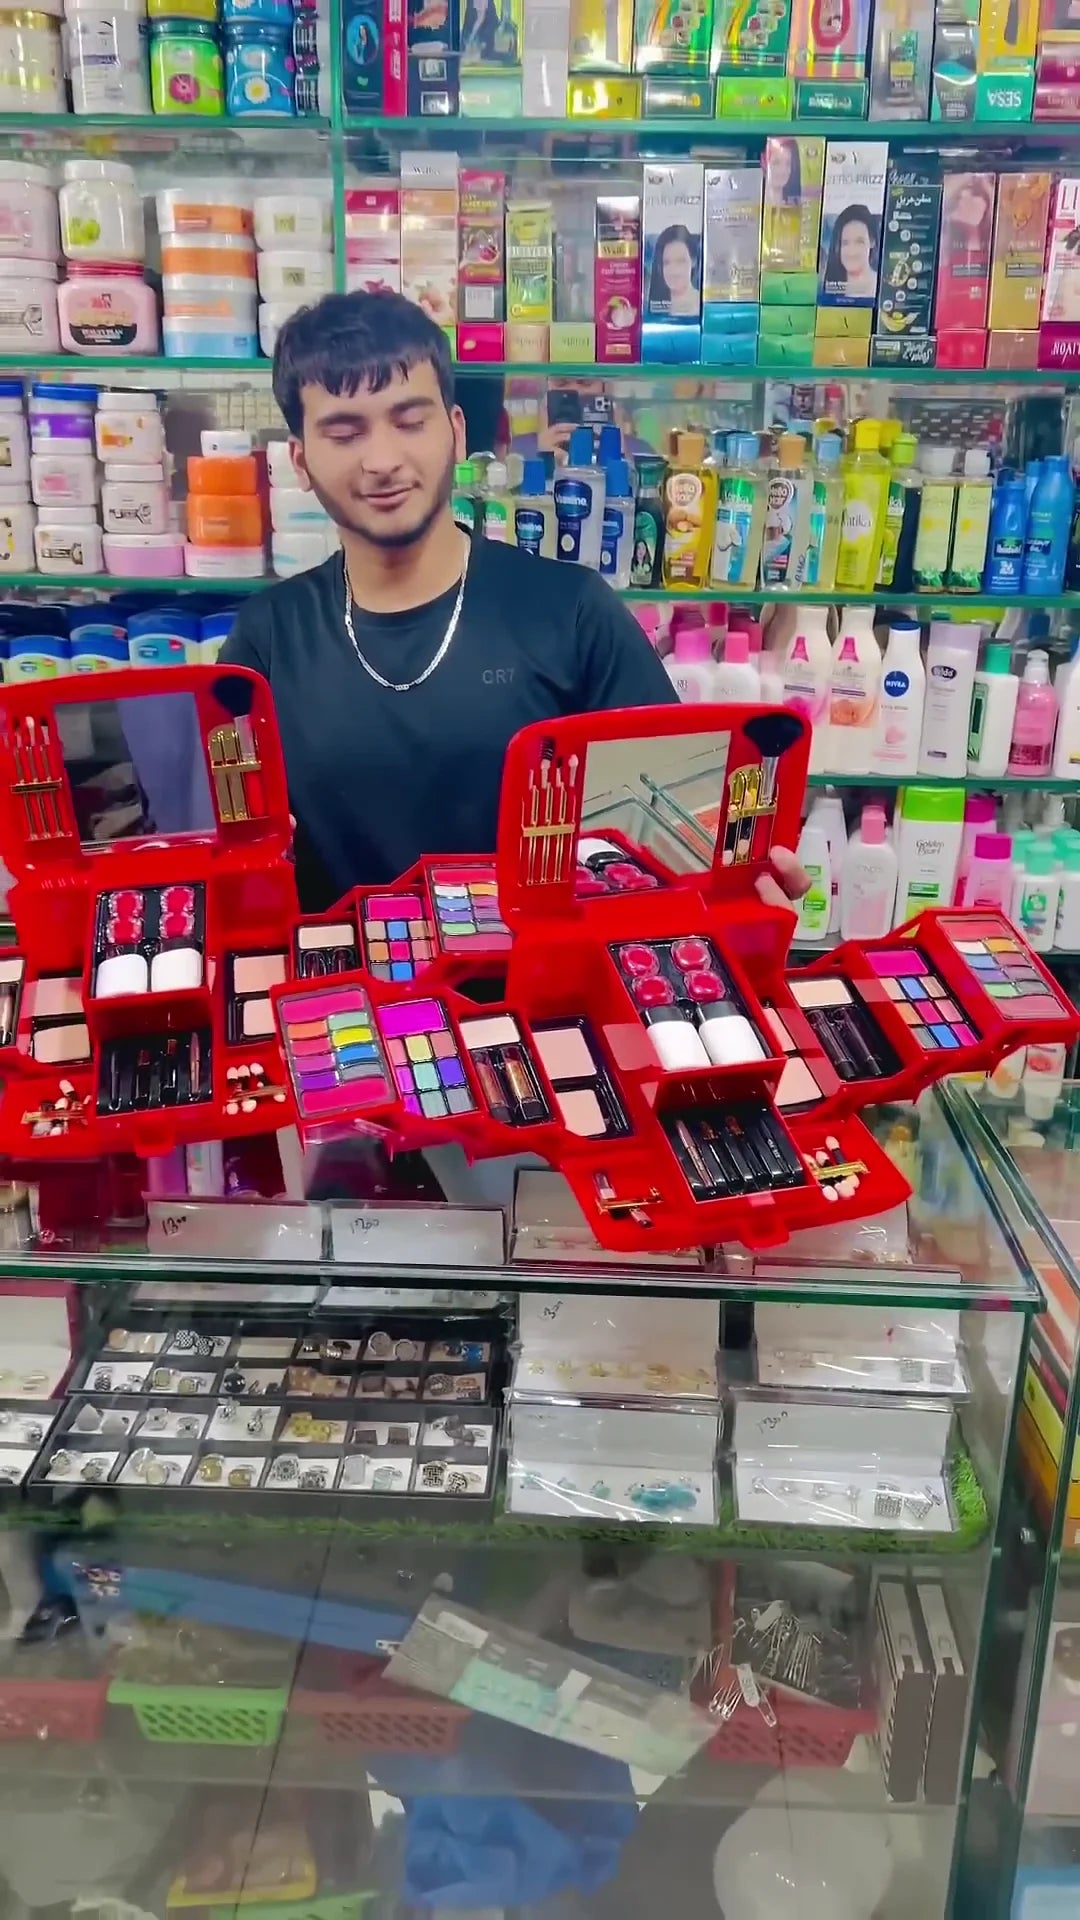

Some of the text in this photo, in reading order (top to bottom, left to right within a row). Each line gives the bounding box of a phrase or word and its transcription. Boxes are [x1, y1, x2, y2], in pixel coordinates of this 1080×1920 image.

[987, 88, 1022, 108] SESA
[482, 668, 515, 684] CR7
[886, 680, 907, 688] NIVEA
